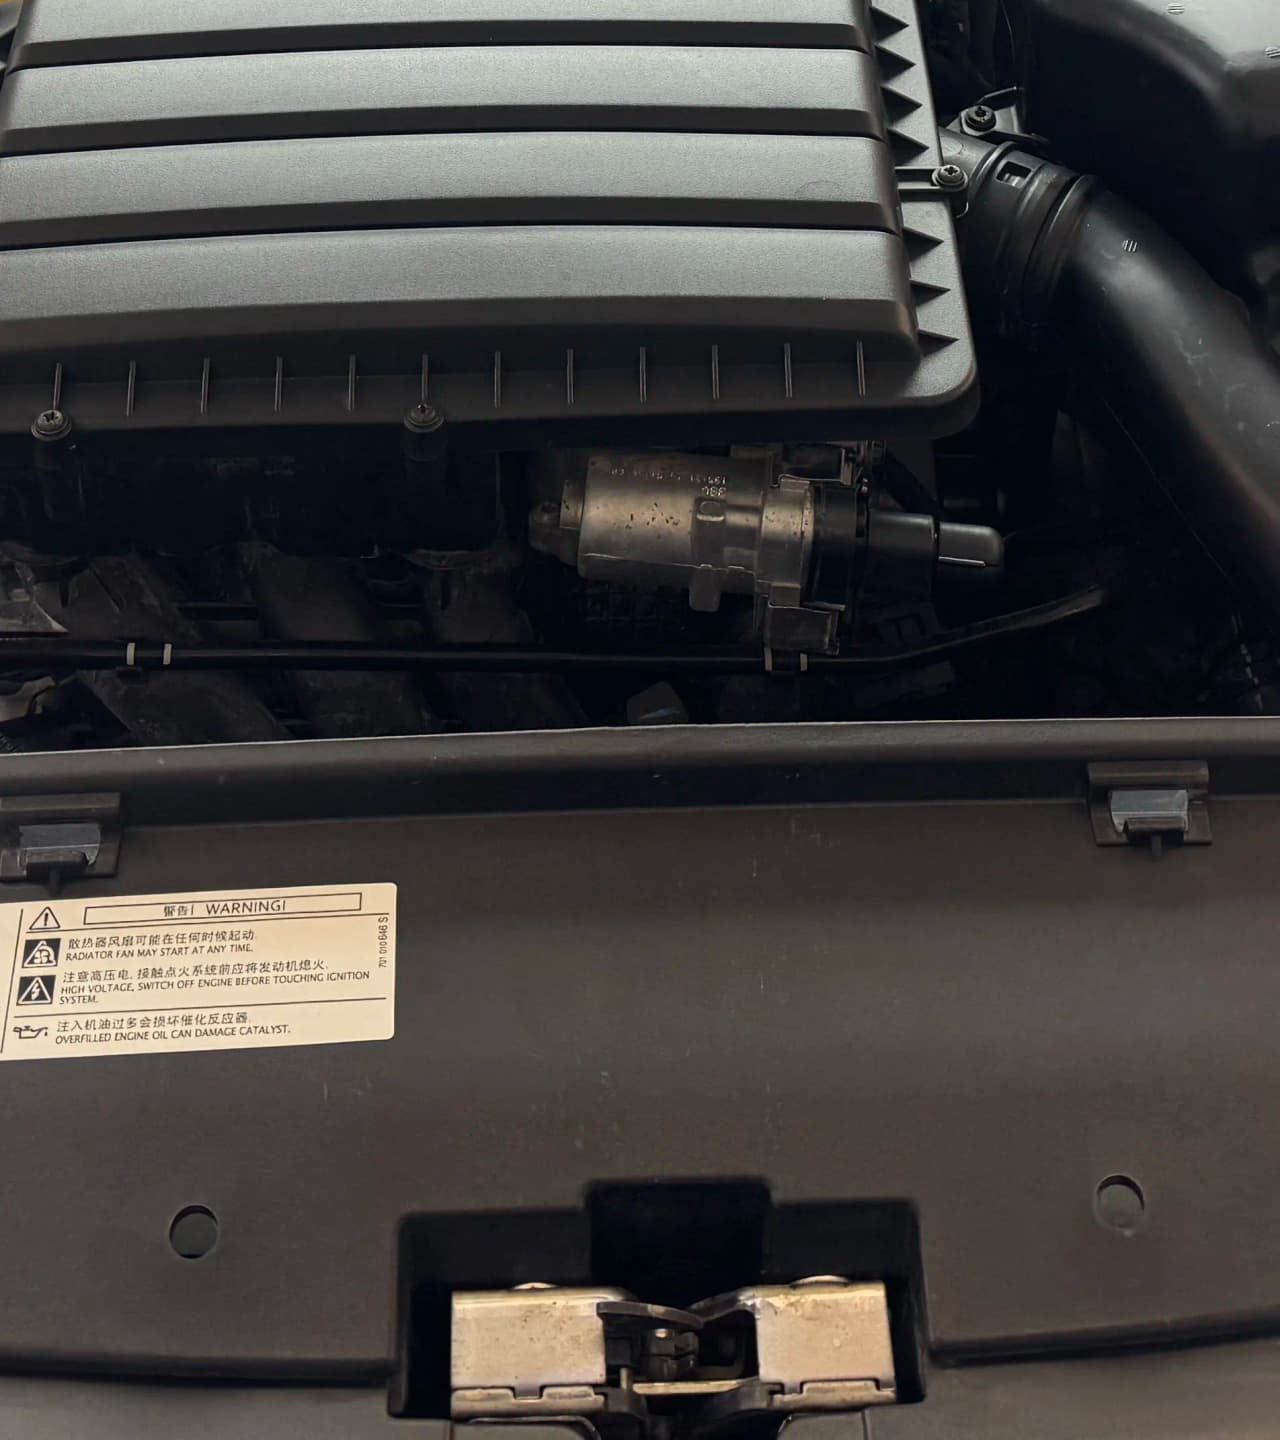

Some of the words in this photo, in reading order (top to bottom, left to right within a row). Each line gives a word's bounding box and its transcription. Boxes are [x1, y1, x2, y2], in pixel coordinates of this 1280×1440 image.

[206, 899, 287, 915] WARNING!
[65, 949, 113, 962] RADIATOR
[116, 949, 134, 959] FAN
[137, 948, 157, 957] MAY
[160, 946, 189, 956] START
[192, 945, 206, 955] AT
[207, 944, 227, 954] ANY
[229, 943, 254, 953] TIME.
[378, 941, 389, 955] 010
[61, 985, 85, 995] HIGH
[88, 982, 135, 993] VOLTAGE,
[138, 981, 174, 991] SWITCH
[177, 980, 195, 989] OFF
[197, 977, 233, 988] ENGINE
[235, 976, 271, 987] BEFORE
[274, 973, 324, 984] TOUCHING
[326, 970, 370, 982] IGNITION
[59, 994, 99, 1005] SYSTEM.
[55, 1033, 112, 1045] OVERFILLED
[114, 1031, 150, 1042] ENGINE
[152, 1030, 169, 1040] OIL
[171, 1028, 192, 1039] CAN
[195, 1026, 237, 1038] DAMAGE
[239, 1024, 292, 1036] CATALYST.
